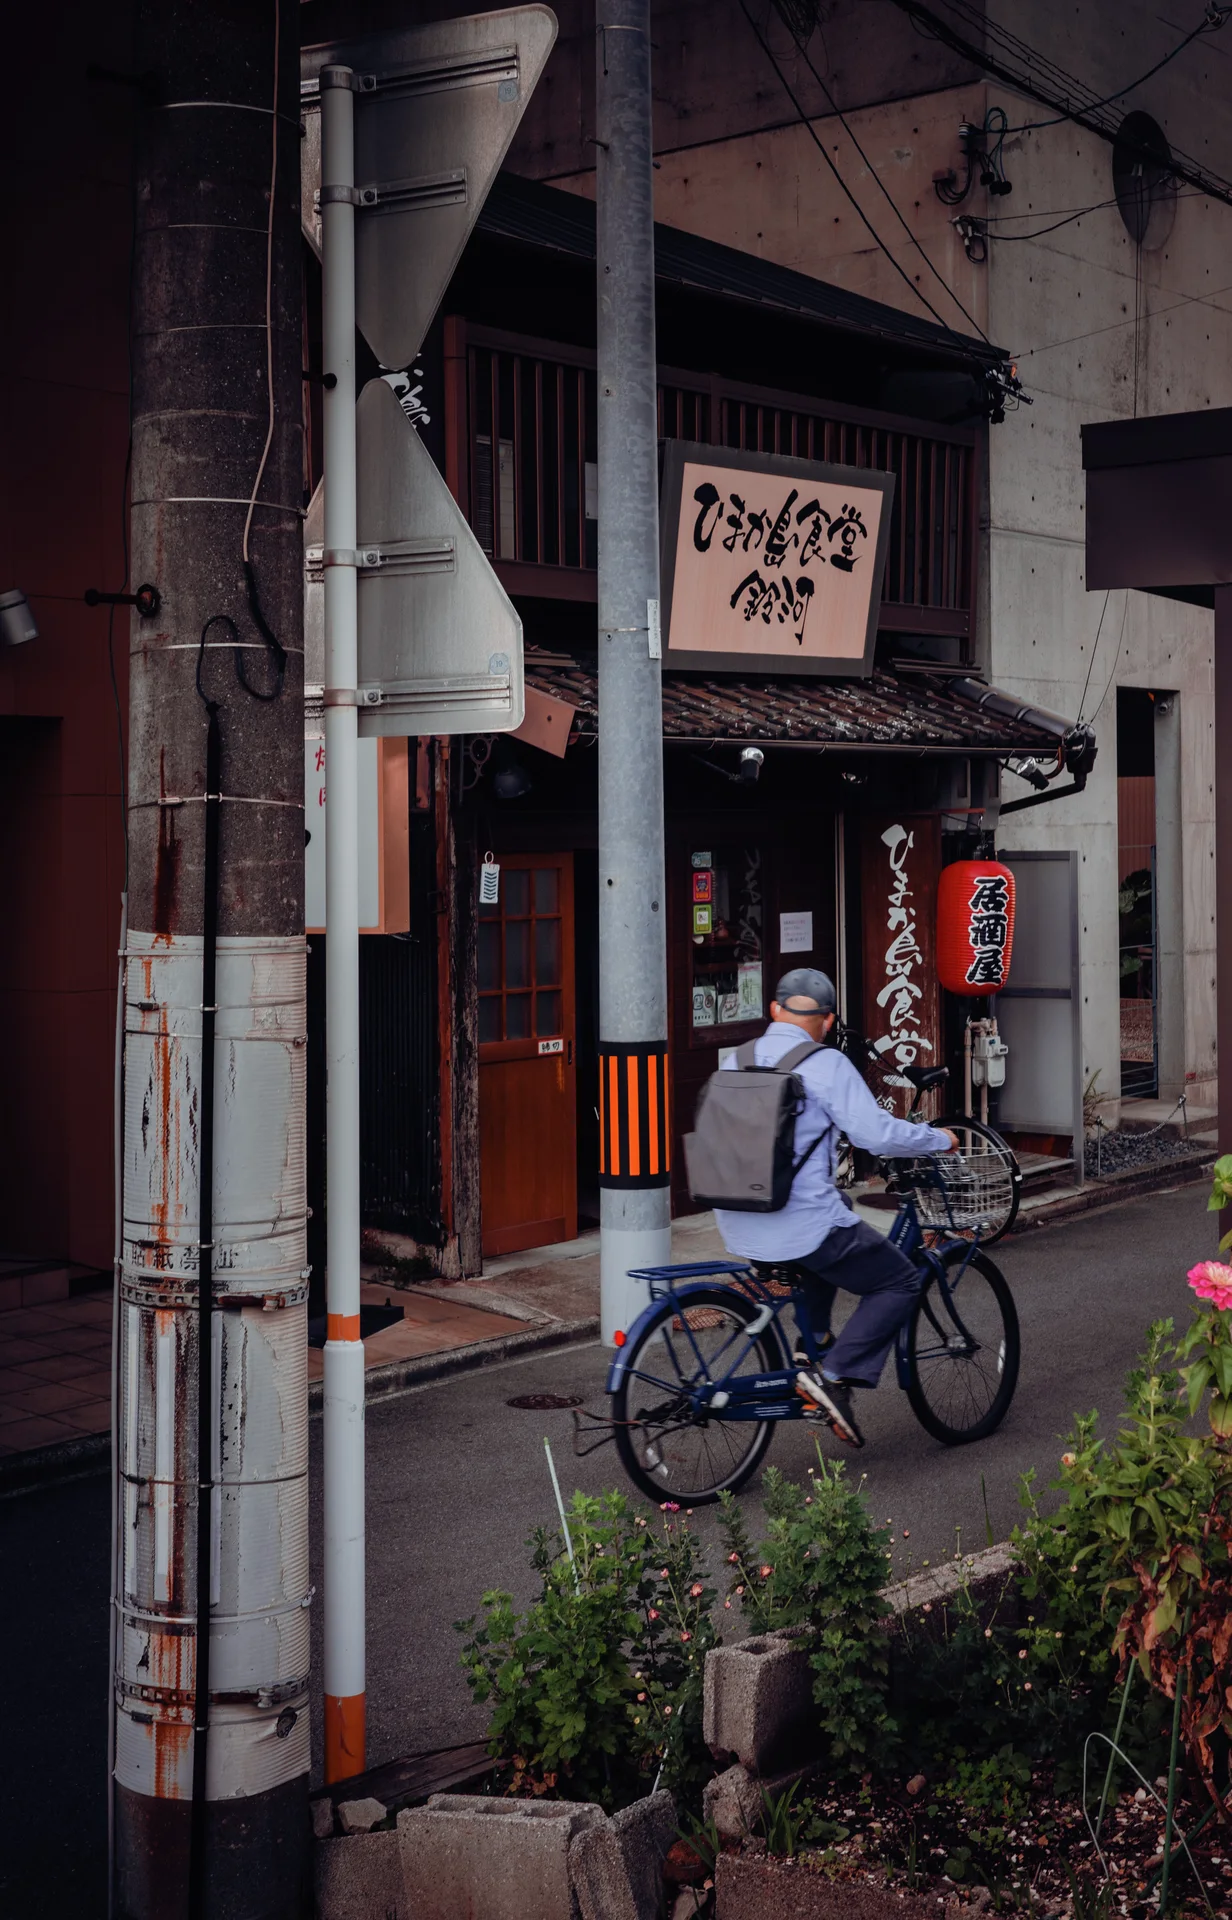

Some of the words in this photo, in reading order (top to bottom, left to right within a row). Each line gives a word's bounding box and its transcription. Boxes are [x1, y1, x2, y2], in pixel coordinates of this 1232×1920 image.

[693, 482, 868, 573] ひまか島食堂
[873, 823, 933, 1089] ひまか島食堂
[965, 875, 1010, 986] 居酒屋
